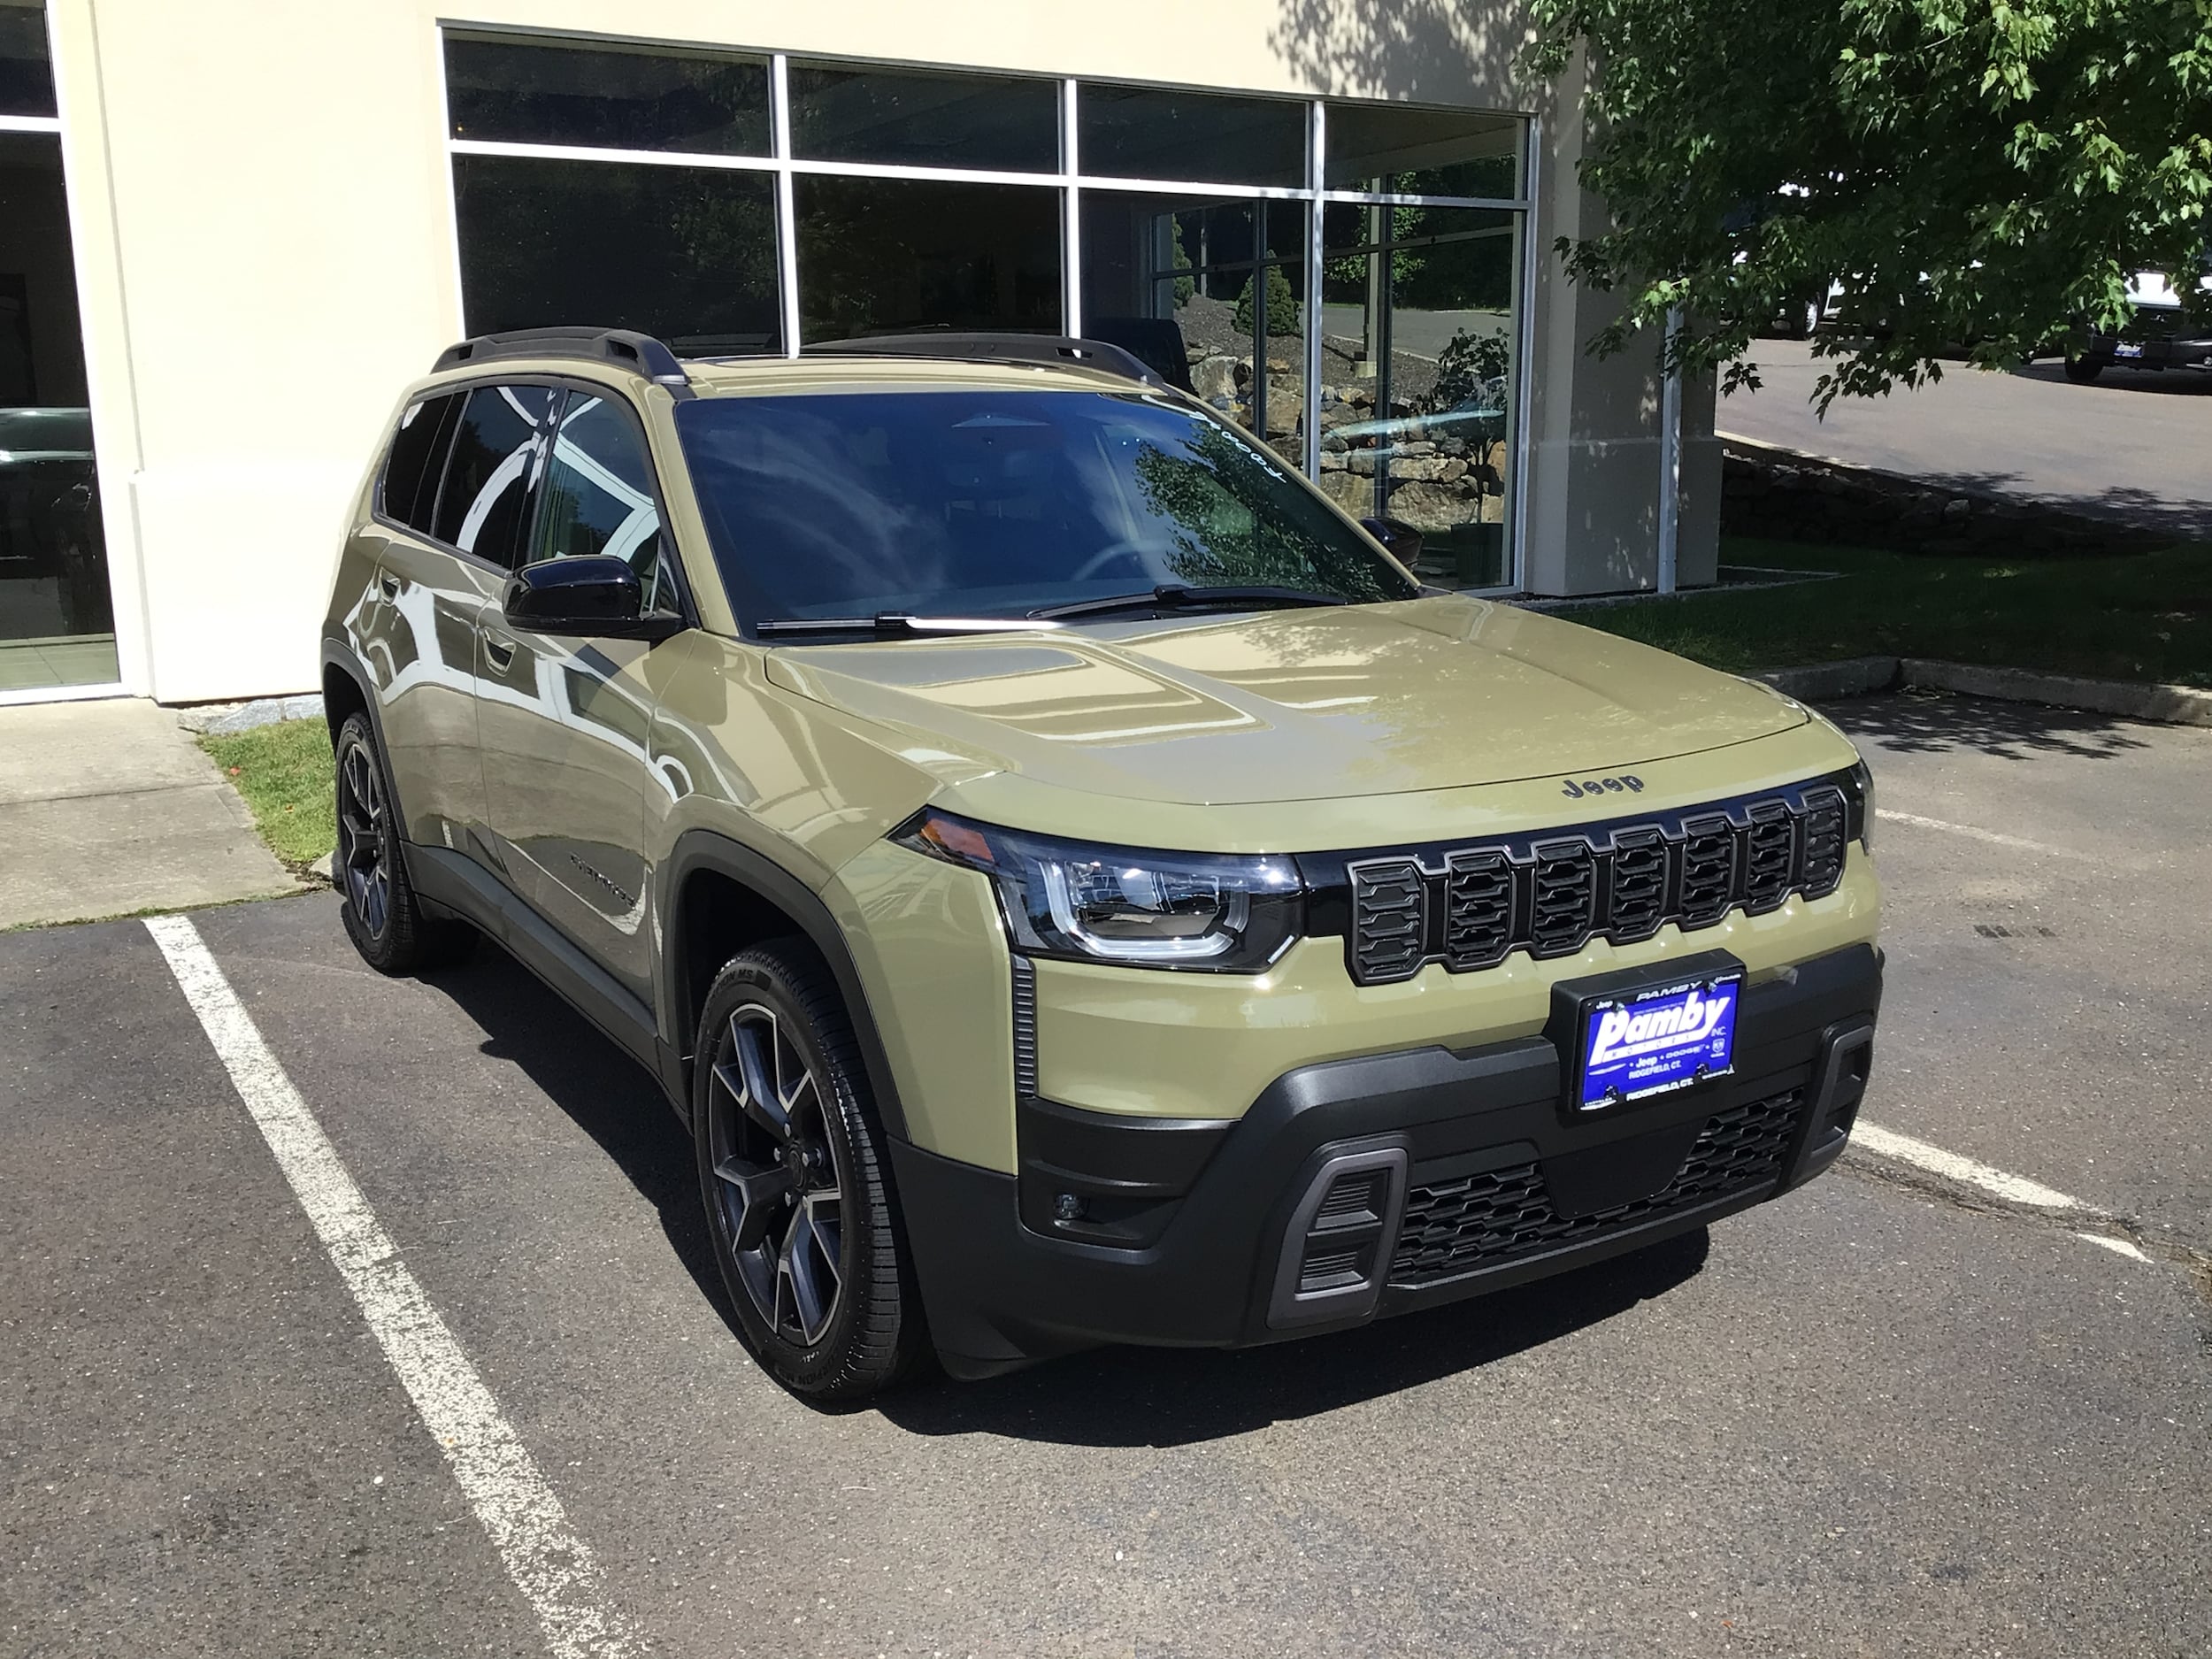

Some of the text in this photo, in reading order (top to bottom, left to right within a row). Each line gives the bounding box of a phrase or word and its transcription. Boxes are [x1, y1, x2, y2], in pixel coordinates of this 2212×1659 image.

[1562, 775, 1644, 799] Jeep
[1636, 980, 1703, 1002] PAMBY
[1588, 991, 1731, 1067] Pamby
[1635, 1056, 1658, 1068] Jeep
